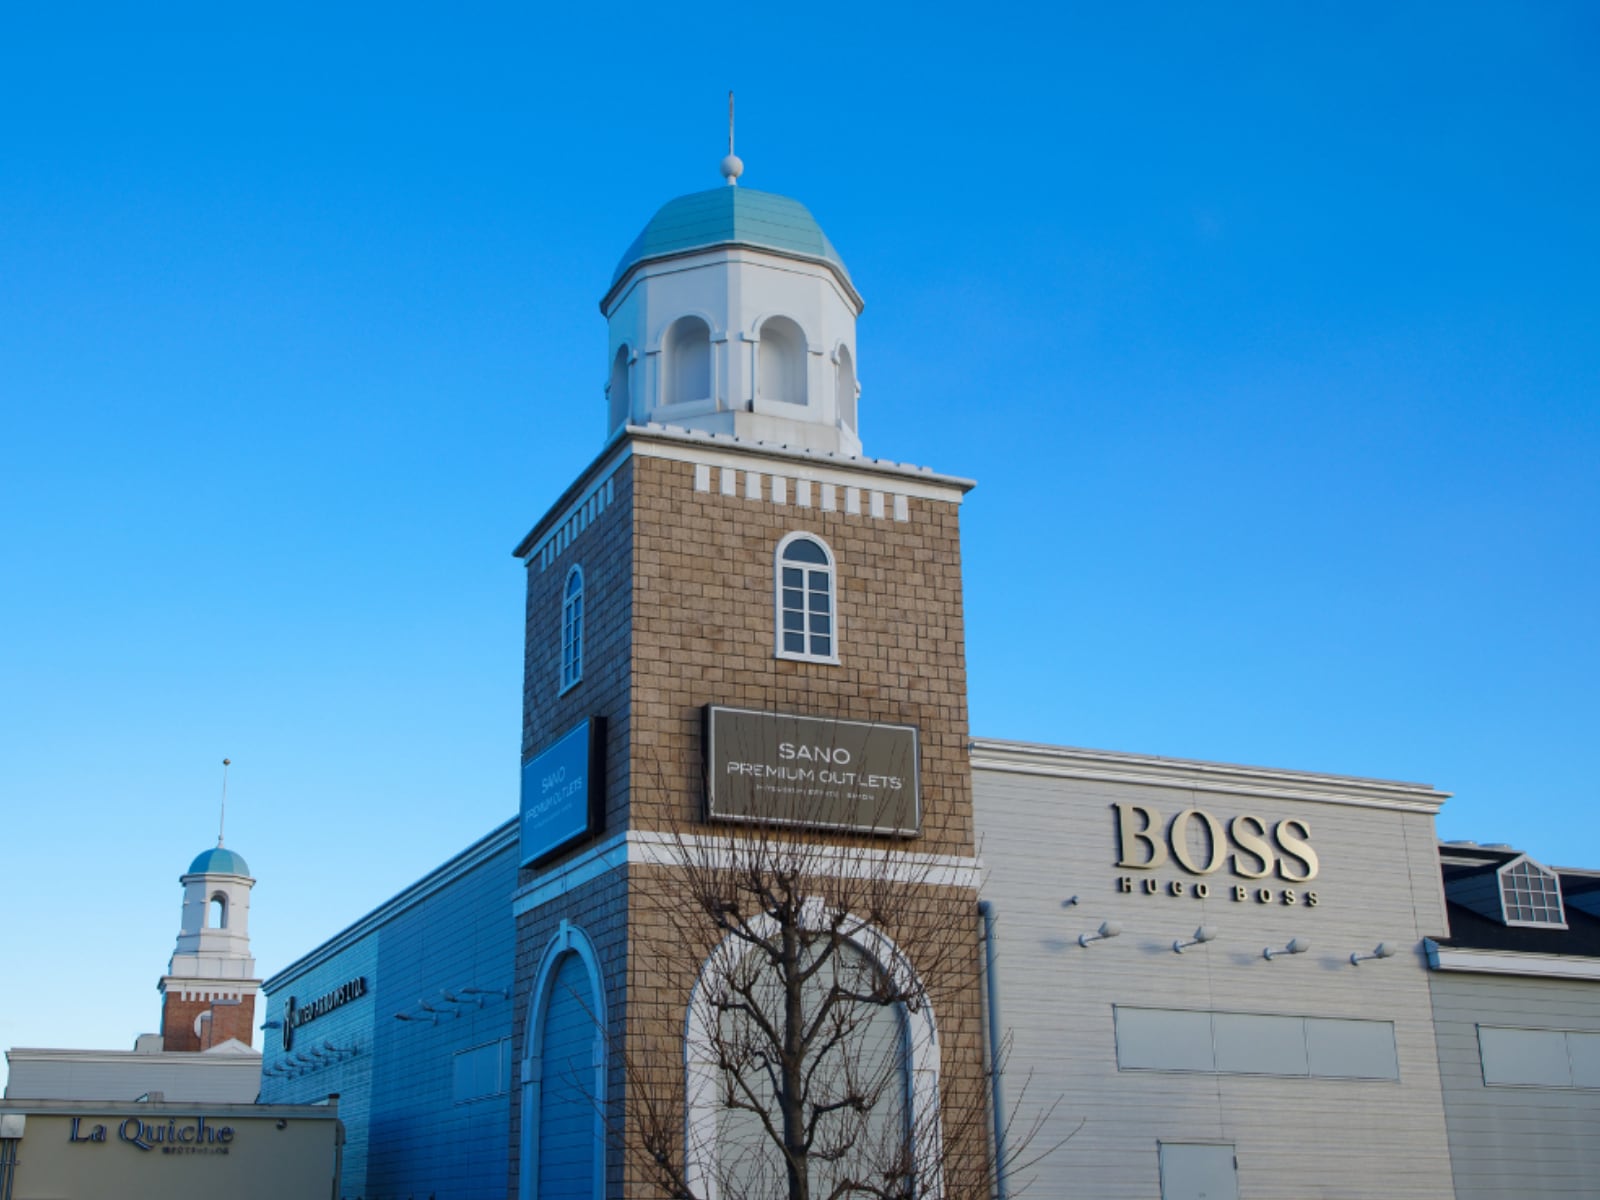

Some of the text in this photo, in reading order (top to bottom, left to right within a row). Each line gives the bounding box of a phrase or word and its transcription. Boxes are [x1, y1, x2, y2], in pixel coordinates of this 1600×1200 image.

[779, 743, 851, 765] SANO
[727, 761, 815, 782] PREMIUM
[819, 769, 903, 790] OUTLETS
[1111, 802, 1320, 883] BOSS
[1117, 876, 1320, 907] HUGO BOSS
[69, 1115, 235, 1151] La Quiche
